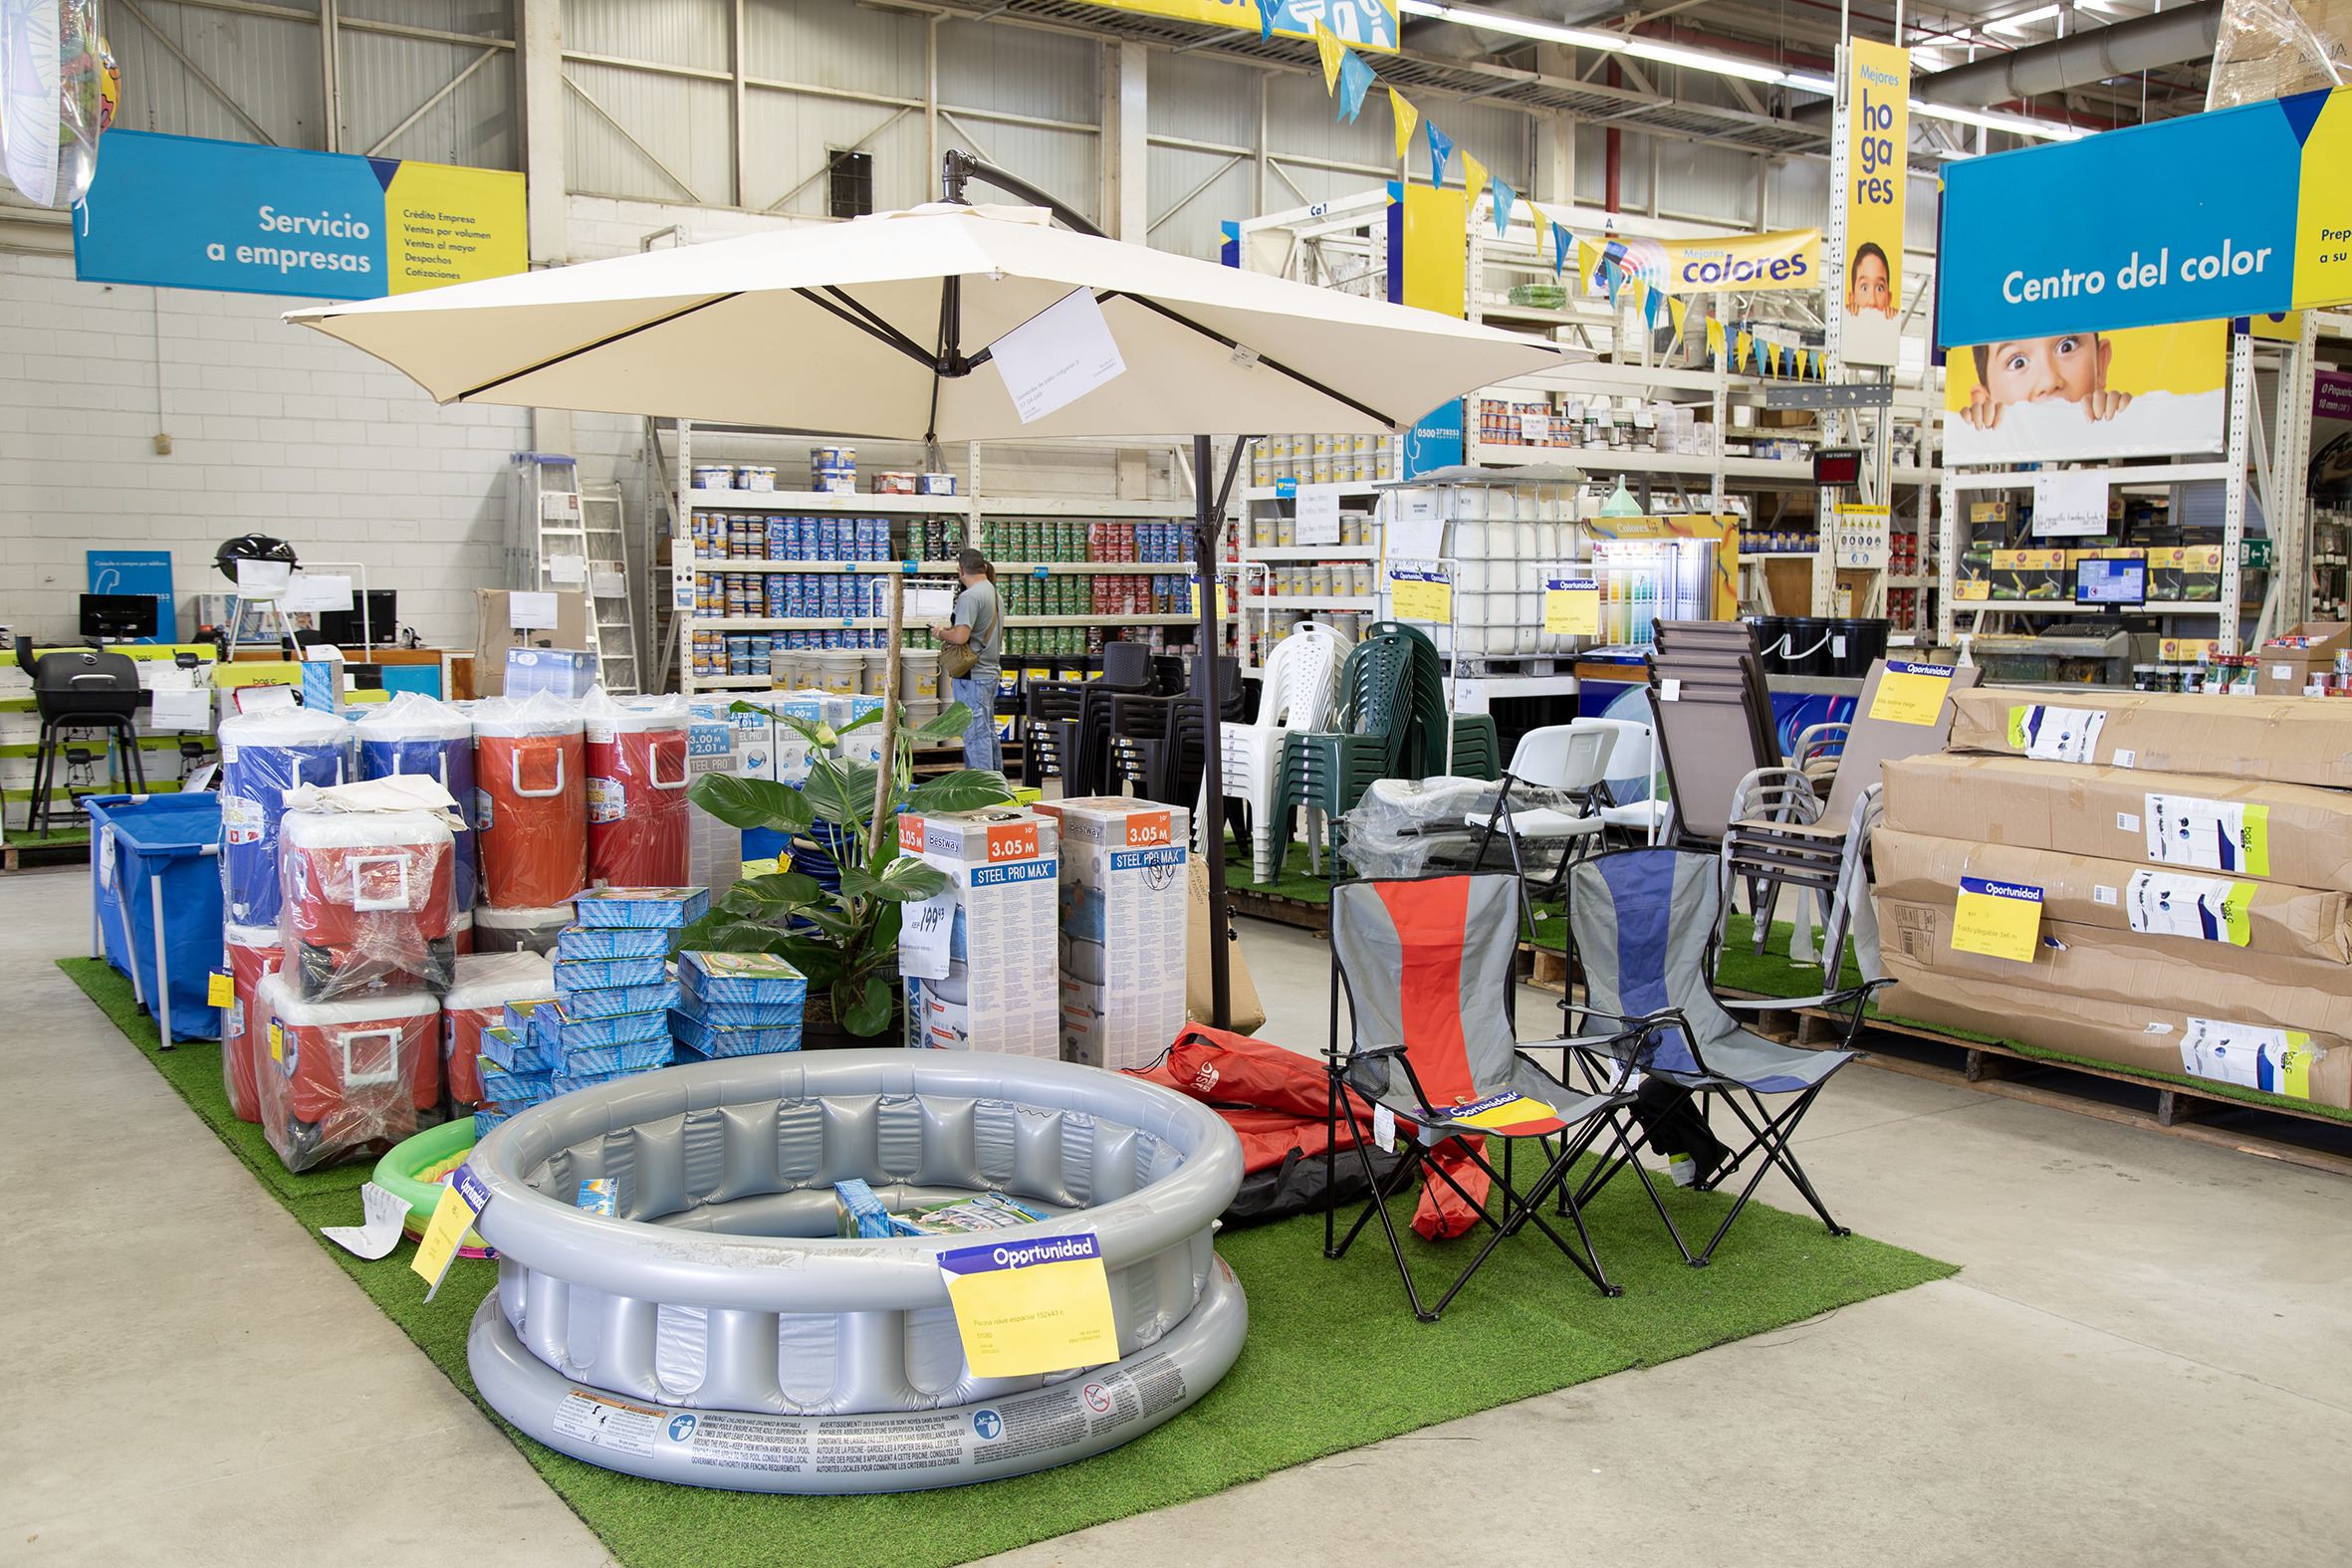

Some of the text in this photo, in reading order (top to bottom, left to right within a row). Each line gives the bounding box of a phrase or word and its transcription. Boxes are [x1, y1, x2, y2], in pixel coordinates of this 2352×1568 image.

[1860, 64, 1899, 87] Mejores
[259, 205, 370, 240] Servicio
[403, 208, 476, 224] Crédito Empresa
[403, 223, 434, 234] Ventas
[455, 229, 491, 239] volumen
[404, 238, 435, 249] Ventas
[449, 244, 476, 254] mayor
[206, 242, 371, 275] a empresas
[405, 253, 452, 265] Despachos
[2320, 252, 2347, 264] a su
[405, 267, 460, 280] Cotizaciones
[1683, 253, 1807, 284] colores
[2002, 238, 2272, 305] Centro del color
[1417, 428, 1435, 438] 0500
[1560, 580, 1596, 590] Oportunidad
[1907, 664, 1952, 676] Oportunidad
[689, 734, 713, 745] 3.00
[696, 744, 717, 754] 2.01
[691, 760, 710, 771] TEEL
[899, 828, 922, 847] 3.05 M
[1069, 821, 1101, 838] Bestway
[1130, 827, 1157, 842] 3.05
[929, 833, 959, 851] Bestway
[992, 839, 1035, 857] 3.05 M
[1116, 852, 1140, 867] STEEL
[1144, 850, 1159, 865] PRO
[978, 868, 1006, 884] STEEL
[1008, 865, 1026, 880] PRO
[1986, 882, 2039, 900] Oportunidad
[908, 991, 921, 1018] MAX
[993, 1237, 1093, 1269] Oportunidad
[840, 1463, 860, 1472] LOCALES
